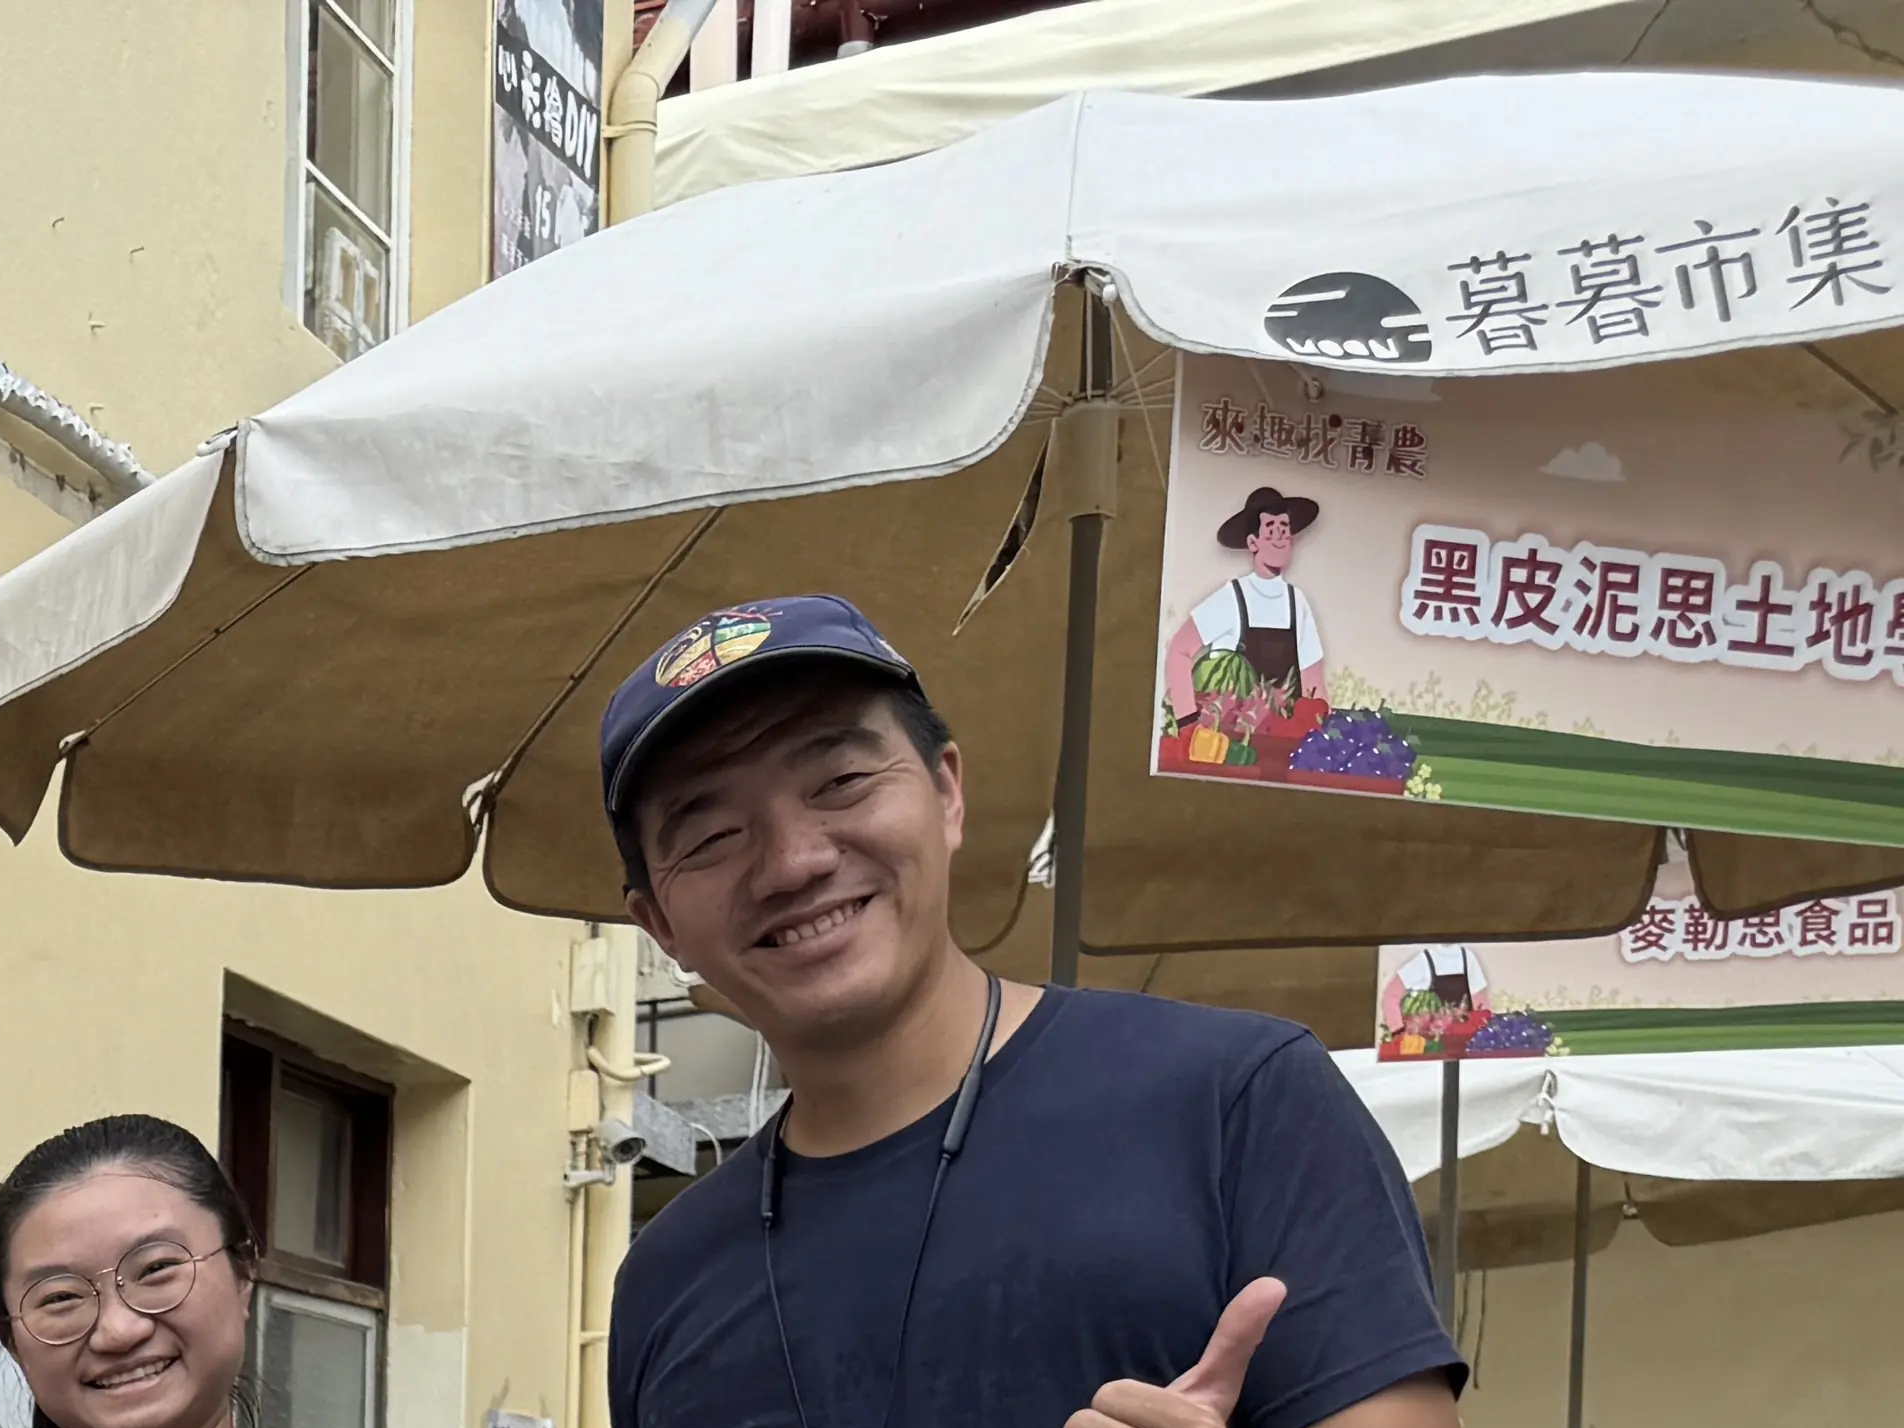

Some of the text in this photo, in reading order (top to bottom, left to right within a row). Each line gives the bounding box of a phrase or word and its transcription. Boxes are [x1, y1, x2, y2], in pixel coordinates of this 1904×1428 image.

[1445, 196, 1892, 355] 暮暮市集
[1199, 398, 1428, 479] 來趣找青農
[1412, 537, 1904, 666] 黑皮泥思土地
